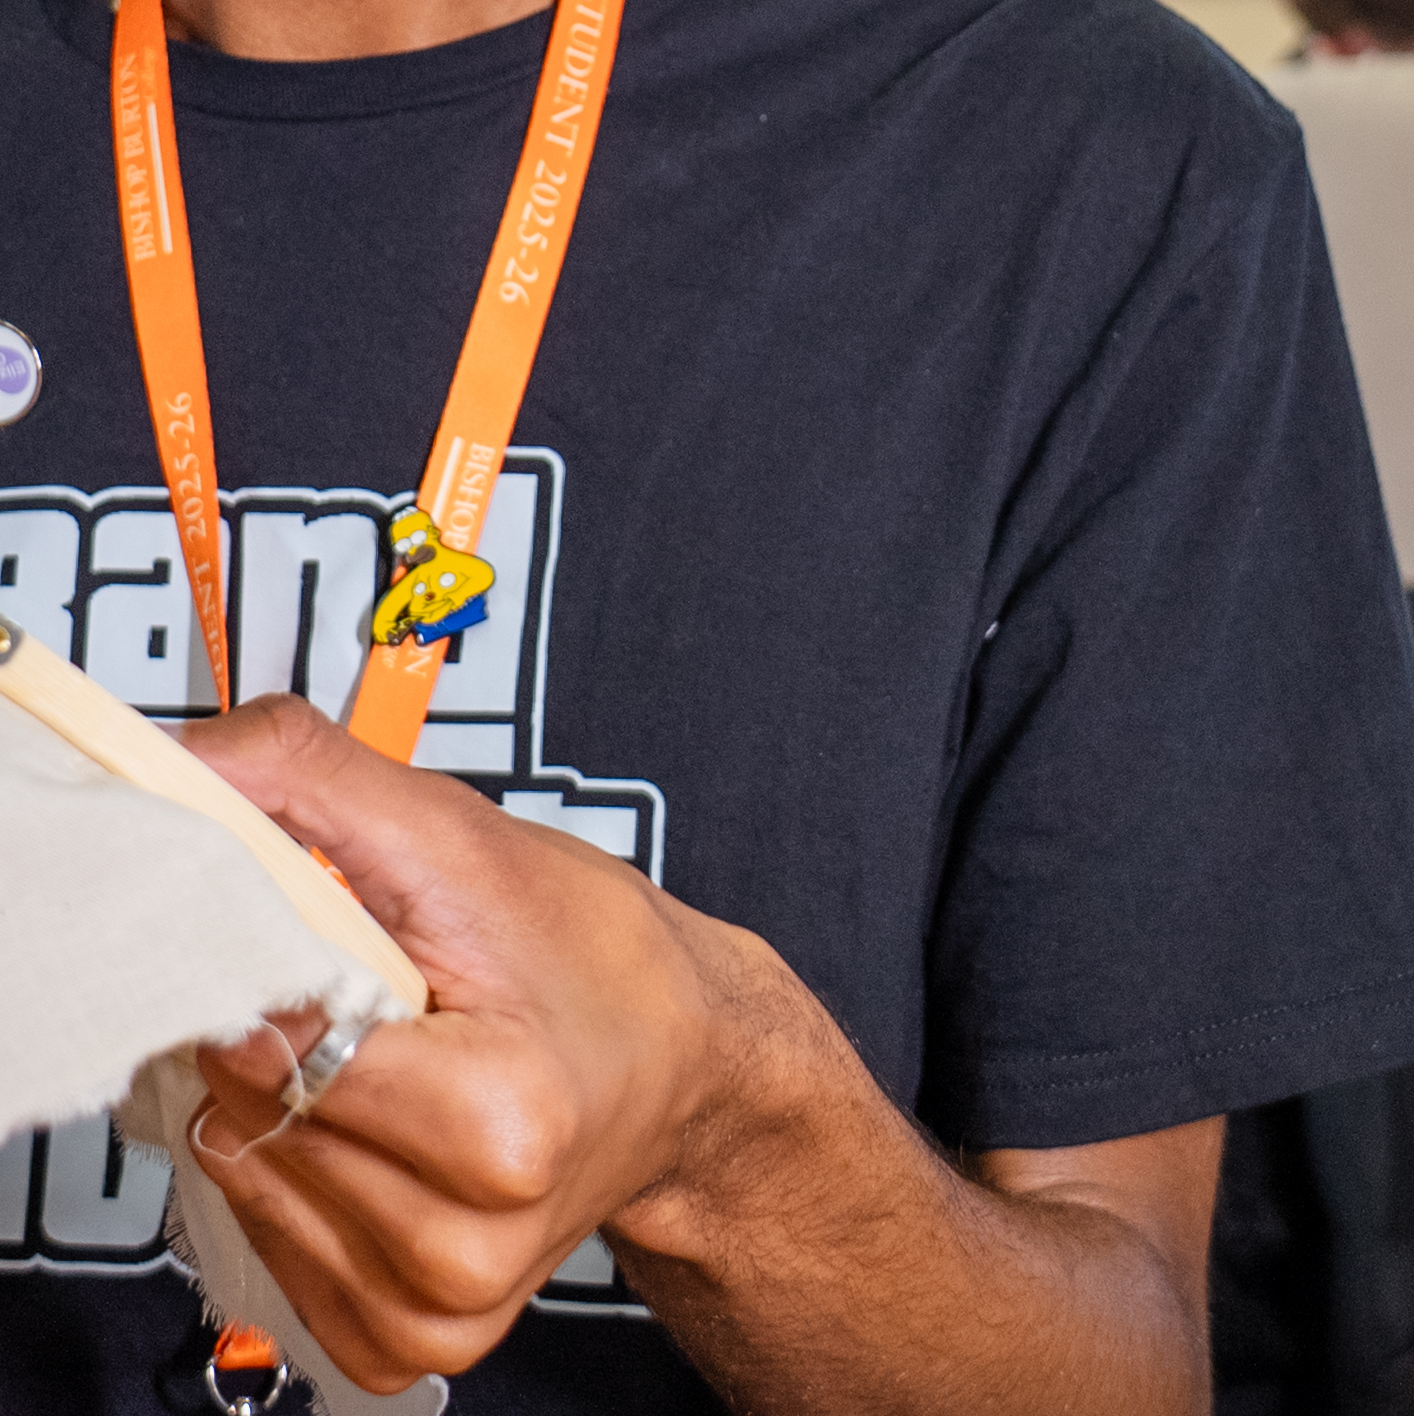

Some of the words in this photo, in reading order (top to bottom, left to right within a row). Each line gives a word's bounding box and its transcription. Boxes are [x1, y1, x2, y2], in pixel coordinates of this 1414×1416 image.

[119, 53, 145, 159] BURTON
[124, 164, 156, 261] BISHOP
[500, 158, 568, 306] 2025-26
[165, 391, 208, 544] 2025-26
[444, 442, 496, 550] BISHOP
